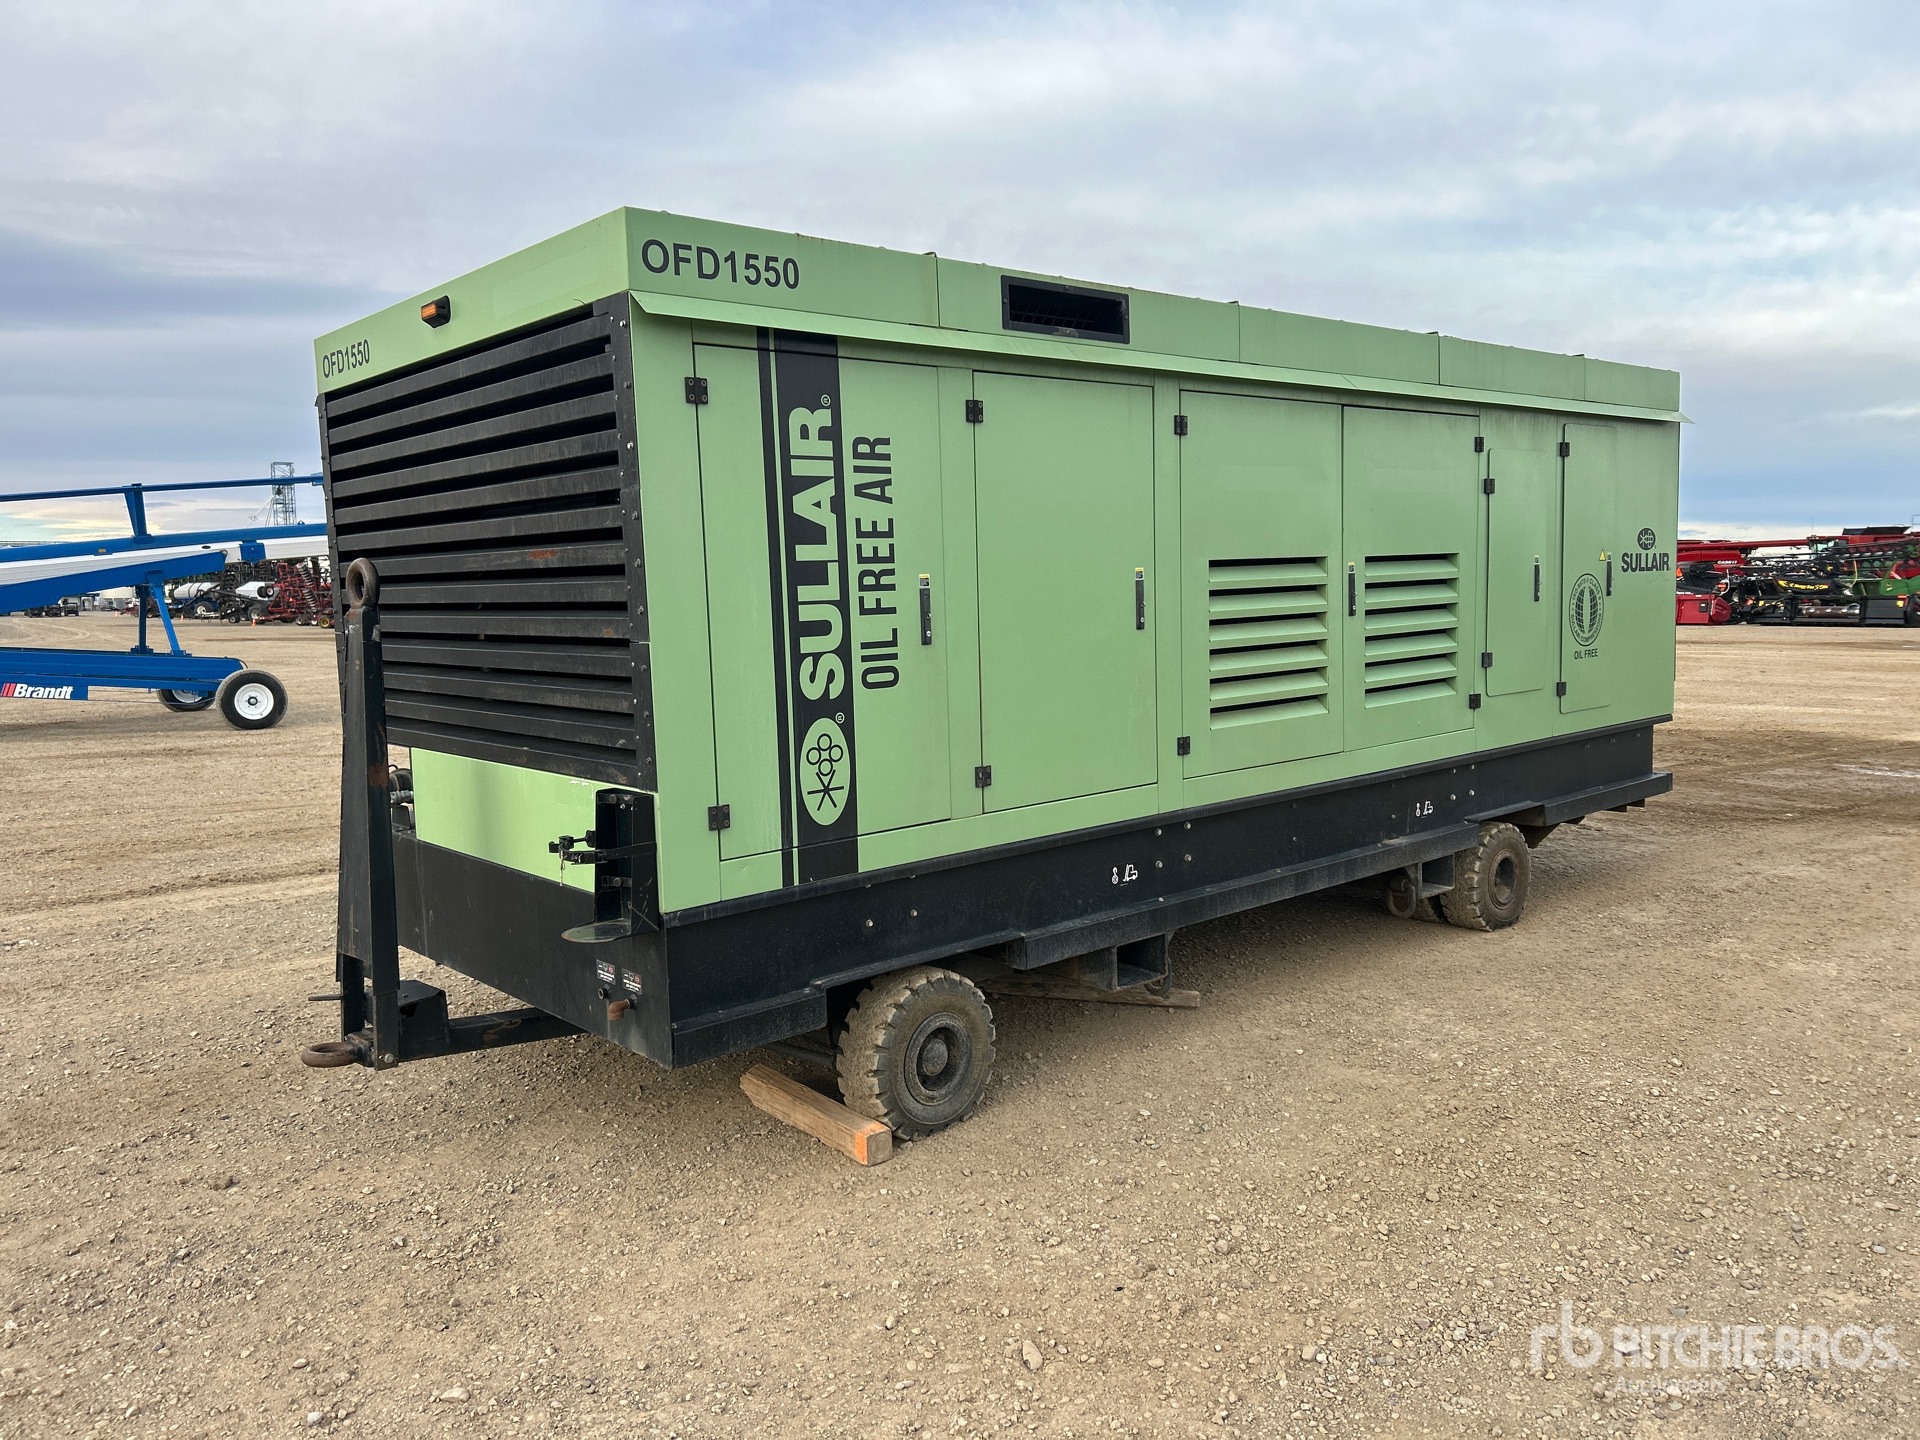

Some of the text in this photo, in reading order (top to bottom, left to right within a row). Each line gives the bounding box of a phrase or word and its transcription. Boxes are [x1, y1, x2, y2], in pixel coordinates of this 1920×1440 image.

[641, 239, 800, 289] OFD1550
[322, 339, 370, 378] OFD1550
[851, 436, 900, 690] OIL FREE AIR
[1621, 552, 1670, 573] SULLAIR
[1573, 648, 1598, 660] OIL FREE
[13, 683, 73, 699] Brandt
